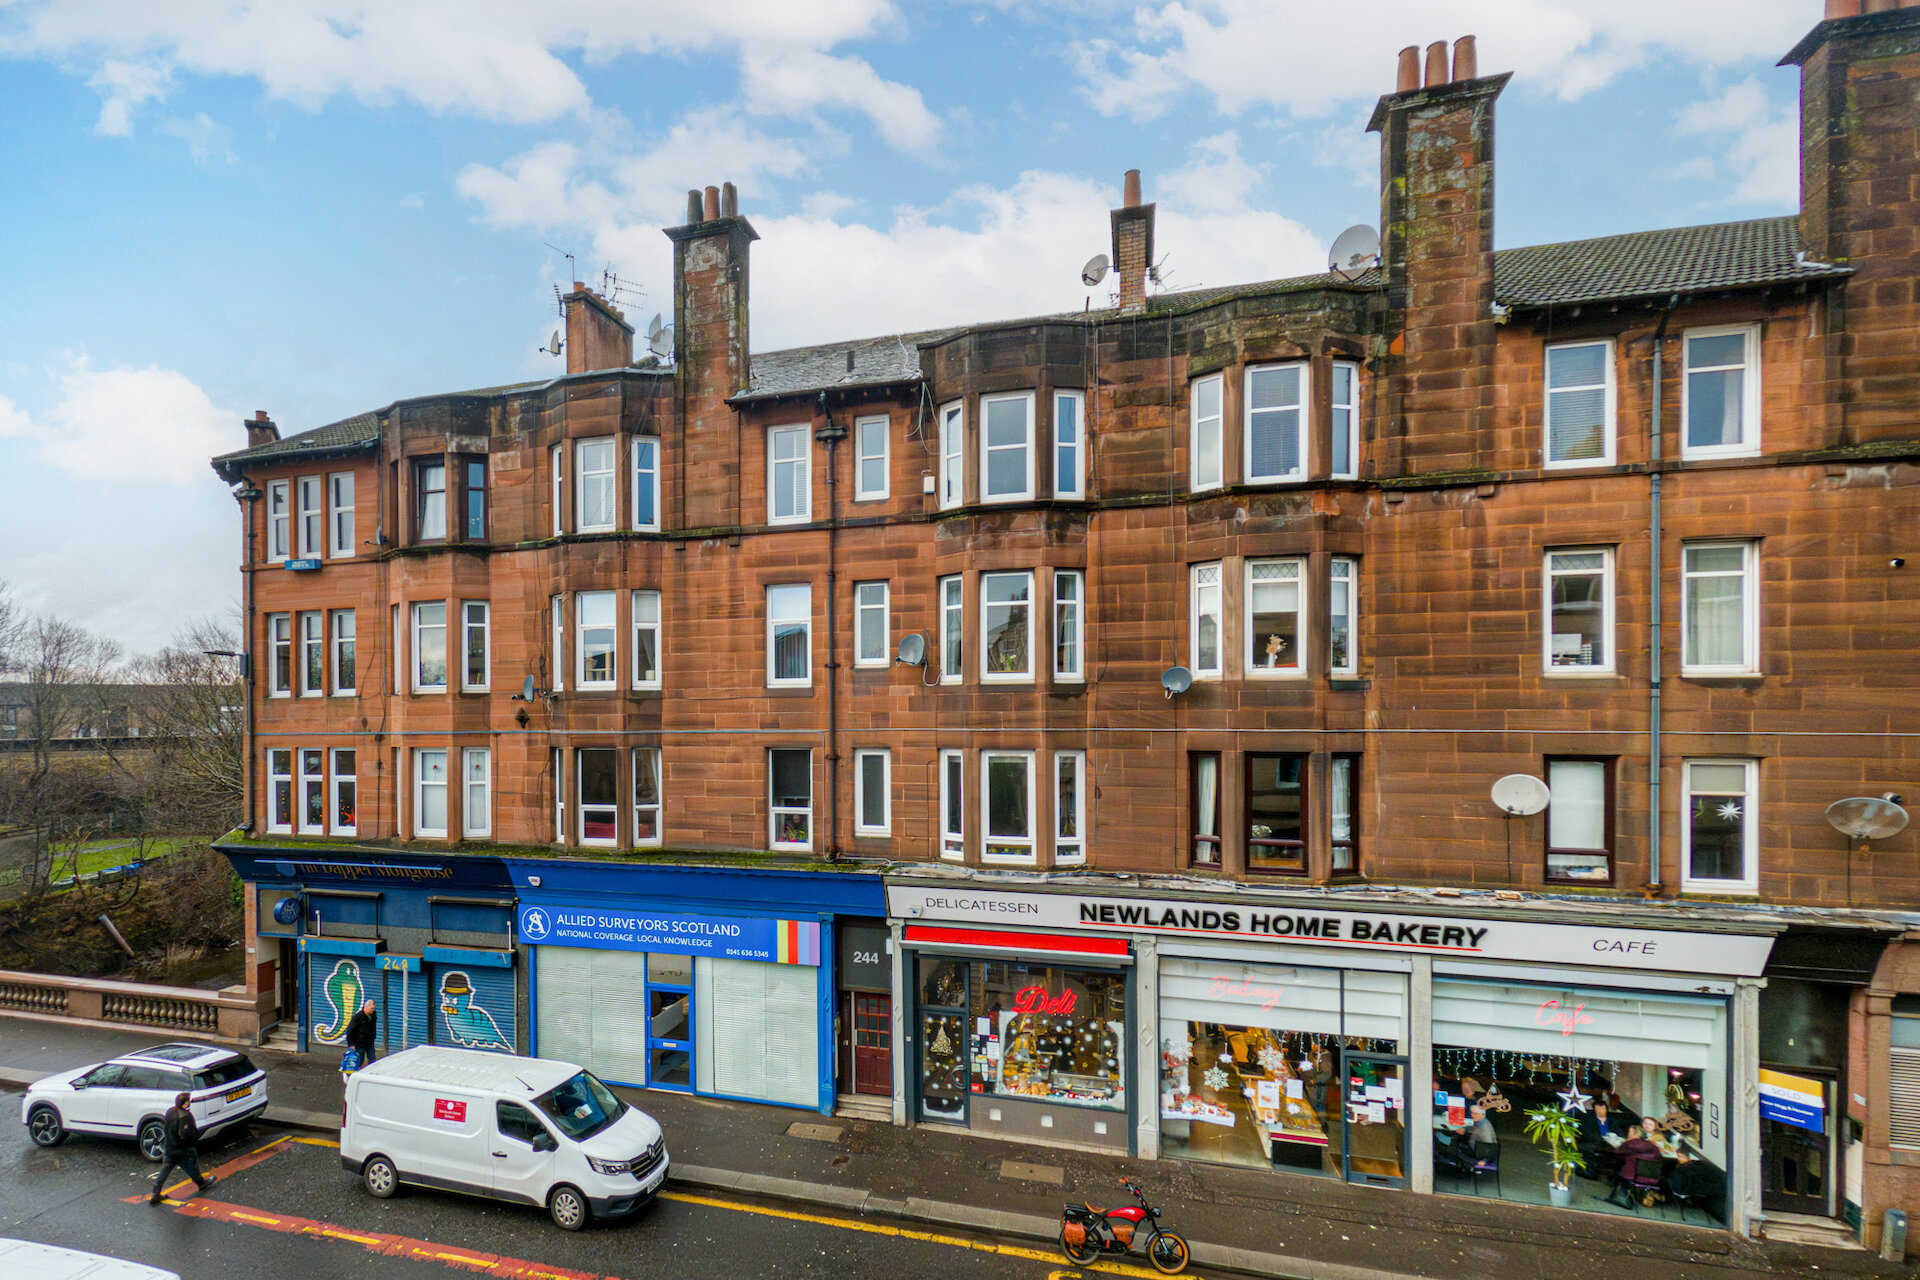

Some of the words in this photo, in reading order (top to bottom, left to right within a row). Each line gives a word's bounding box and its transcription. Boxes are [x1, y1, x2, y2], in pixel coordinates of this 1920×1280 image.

[925, 897, 1039, 914] DELICATESSEN
[556, 913, 596, 927] ALLIED
[598, 916, 669, 932] SURVEYORS
[672, 920, 741, 937] SCOTLAND
[1080, 902, 1241, 931] NEWLANDS
[1250, 913, 1342, 938] HOME
[1351, 919, 1489, 948] BAKERY
[556, 929, 592, 939] NATIONAL
[637, 934, 662, 944] LOCAL
[663, 936, 713, 948] KNOWLEDGE
[1593, 938, 1658, 955] CAFÉ
[725, 947, 740, 956] 0141
[741, 949, 753, 957] 636
[753, 949, 769, 958] 5345
[852, 951, 880, 965] 244
[1010, 986, 1078, 1015] Deli
[1208, 974, 1285, 1013] Bakery
[1535, 1000, 1597, 1037] Cafe
[1771, 1087, 1802, 1101] SOLD
